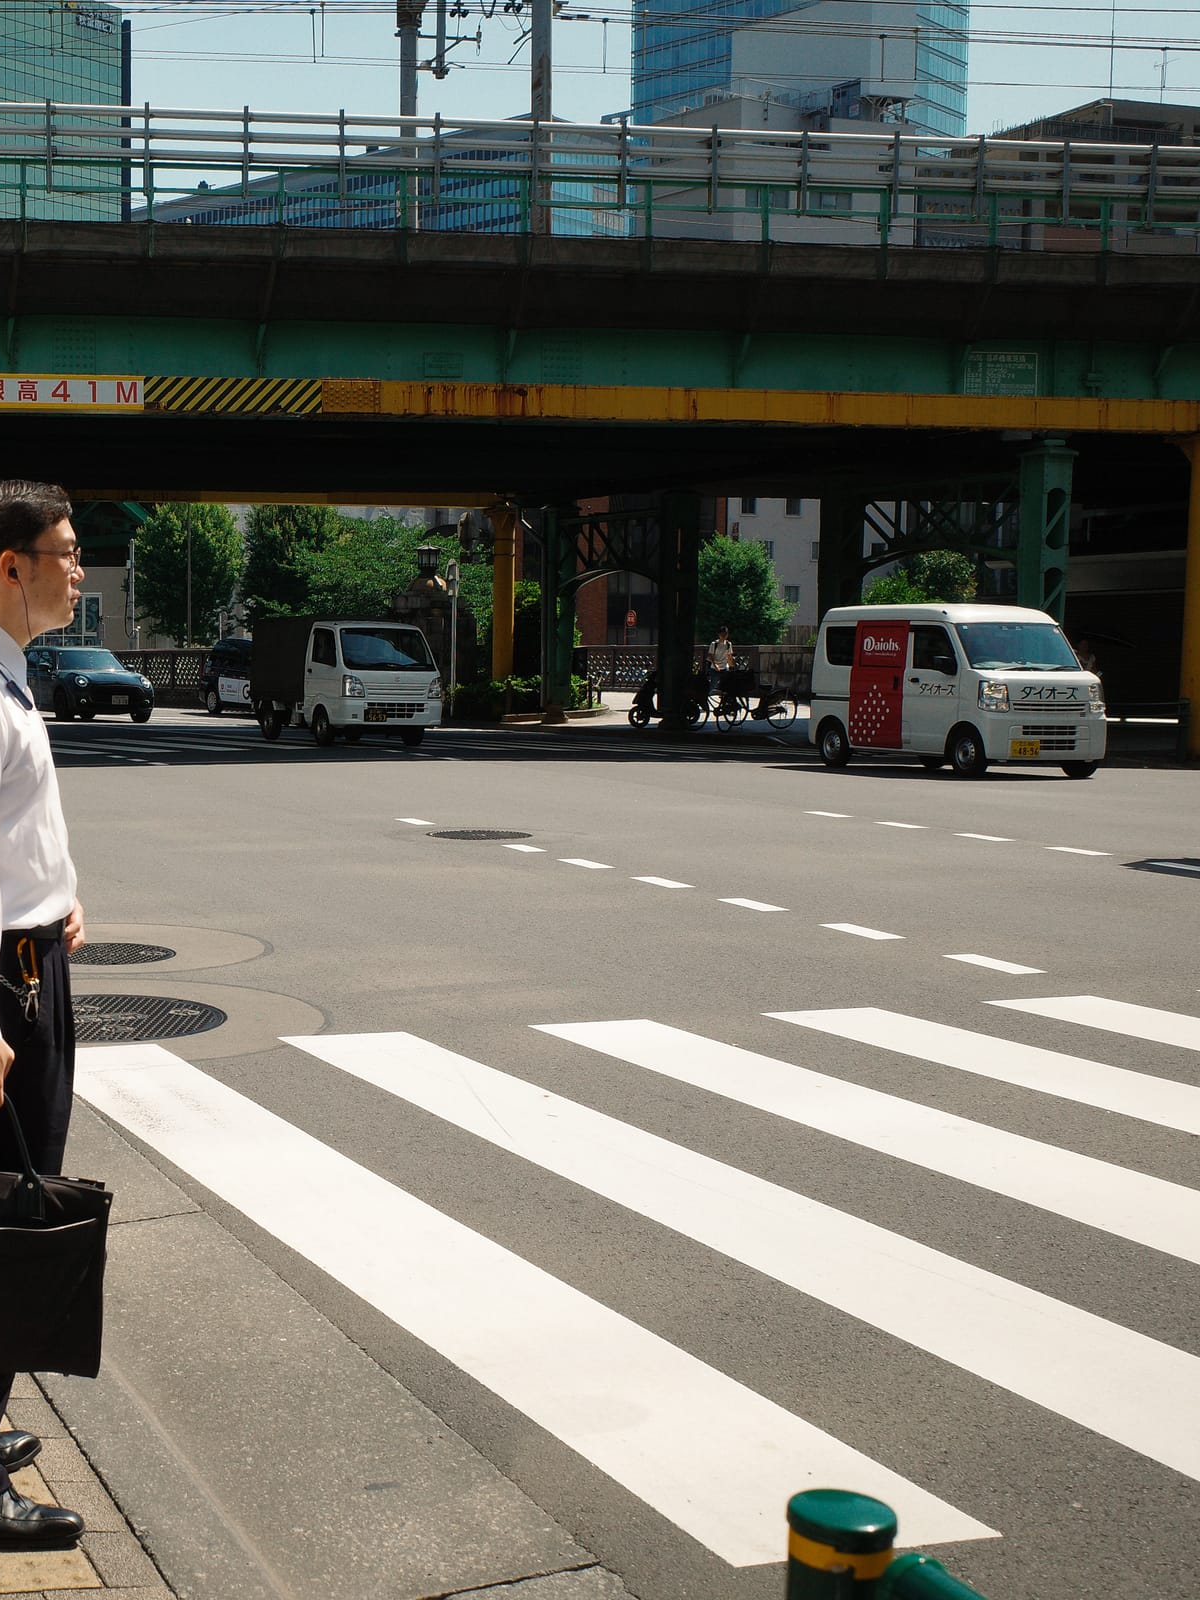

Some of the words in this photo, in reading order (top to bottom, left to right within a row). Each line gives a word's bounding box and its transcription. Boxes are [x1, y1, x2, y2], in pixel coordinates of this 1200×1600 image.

[863, 636, 899, 652] Daiohs
[919, 683, 956, 695] ダイオーズ
[1021, 686, 1079, 700] ダイオーズ
